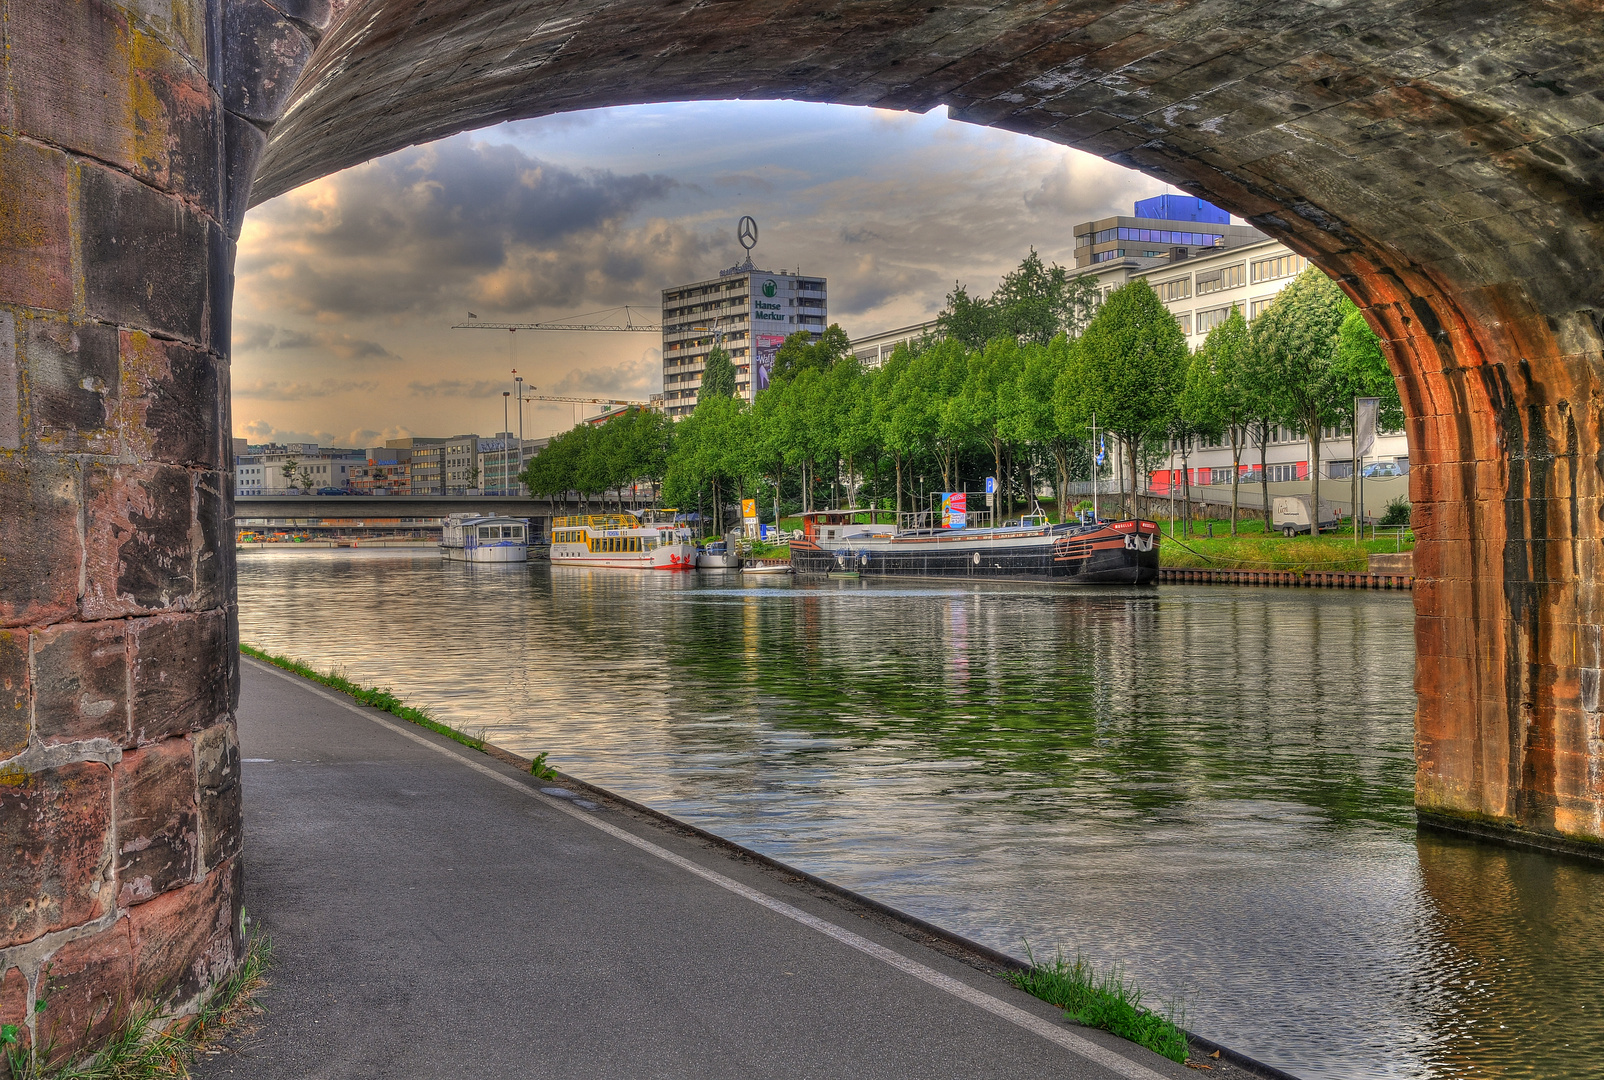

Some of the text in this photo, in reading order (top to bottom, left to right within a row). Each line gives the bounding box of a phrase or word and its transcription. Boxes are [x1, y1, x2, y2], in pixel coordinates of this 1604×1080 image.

[755, 301, 781, 310] Hanse
[755, 310, 785, 320] Merkur
[988, 480, 992, 492] P
